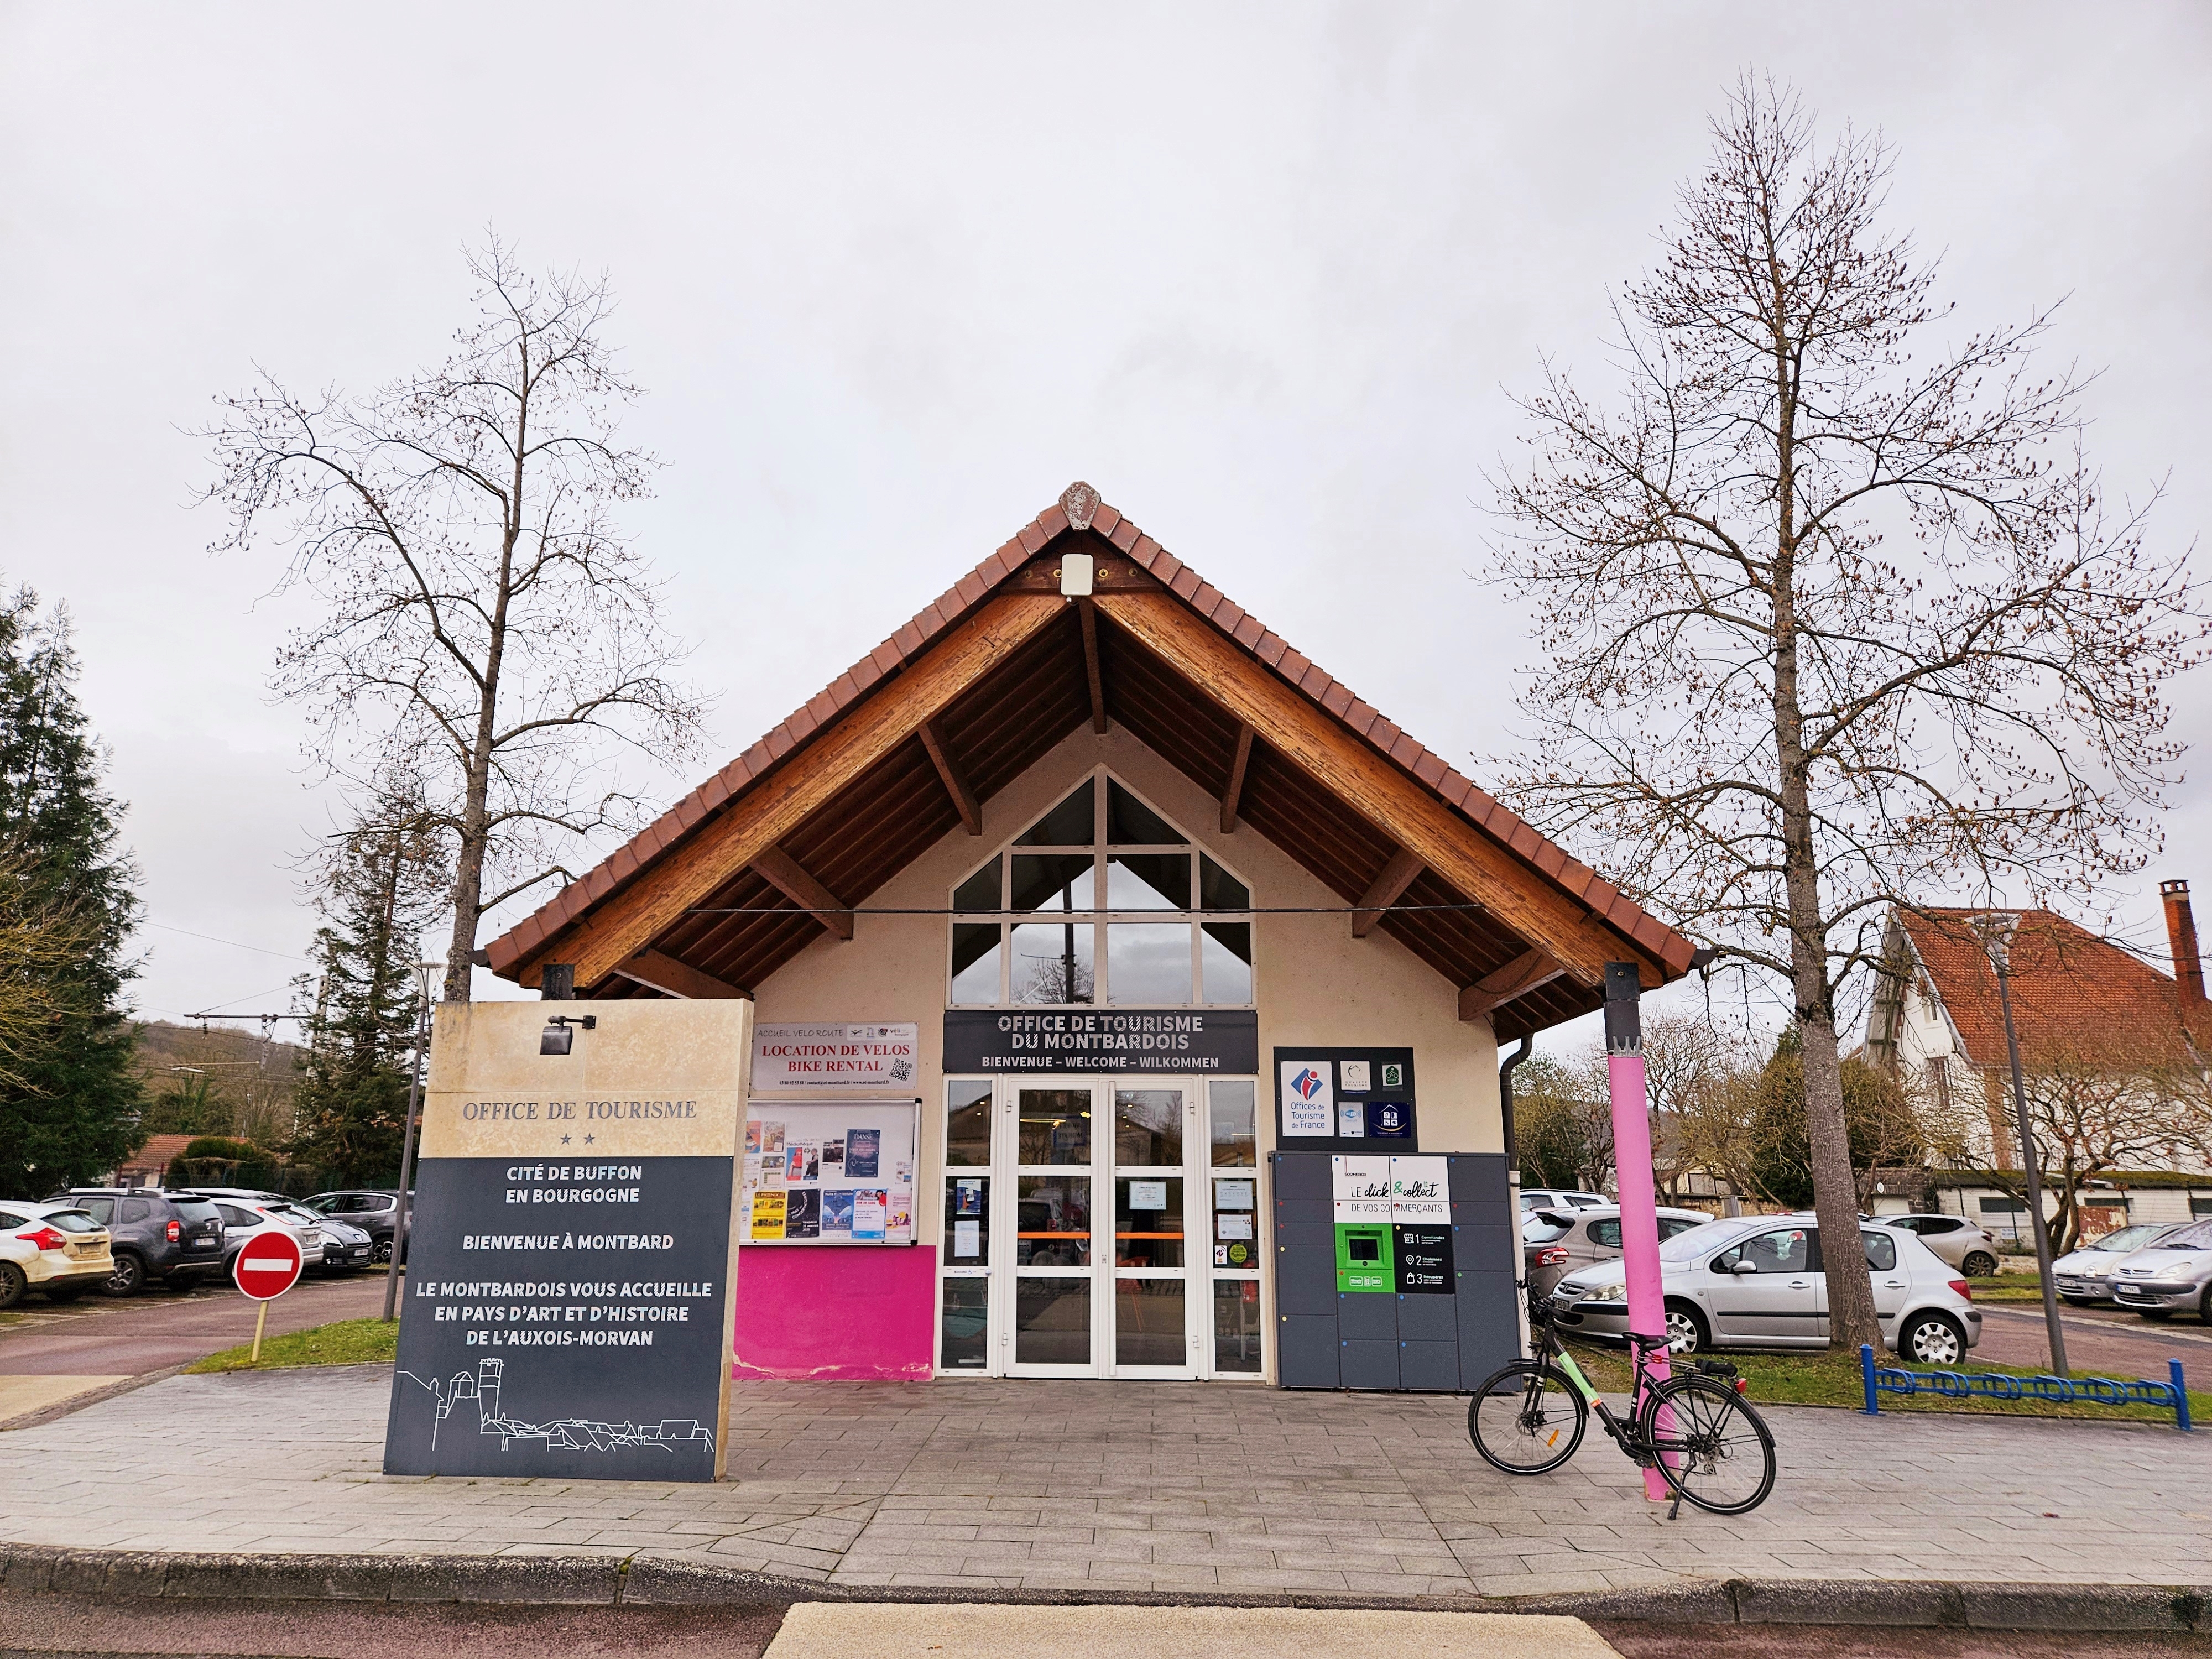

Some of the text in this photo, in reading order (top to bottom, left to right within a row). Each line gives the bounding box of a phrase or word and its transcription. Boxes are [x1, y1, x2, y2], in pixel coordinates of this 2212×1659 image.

[998, 1016, 1203, 1031] OFFICE DE TOURISME
[1012, 1034, 1189, 1050] DU MONTBARDOIS
[762, 1045, 910, 1056] LOCATION DE VELOS
[788, 1061, 883, 1072] BIKE RENTAL
[982, 1056, 1053, 1067] BIENVENUE
[1065, 1057, 1126, 1067] WELCOME
[1139, 1057, 1219, 1068] WILKOMMEN
[462, 1100, 697, 1120] OFFICE DE TOURISME
[1291, 1102, 1316, 1110] Offices
[506, 1163, 641, 1181] CITÉ DE BUFFON
[505, 1188, 640, 1203] EN BOURGOGNE
[1350, 1187, 1361, 1197] LE
[1365, 1182, 1389, 1198] click
[1380, 1204, 1443, 1214] COMMERÇANTS
[463, 1232, 674, 1250] BIENVENUE À MONTBARD
[1415, 1234, 1420, 1244] 1
[1416, 1255, 1422, 1266] 2
[1417, 1273, 1422, 1284] 3
[416, 1281, 712, 1297] LE MONTBARDOIS VOUS ACCUEILLE
[435, 1306, 689, 1321] EN PAYS D’ART ET D’HISTOIRE
[466, 1329, 653, 1346] DE L’AUXOIS-MORVAN
